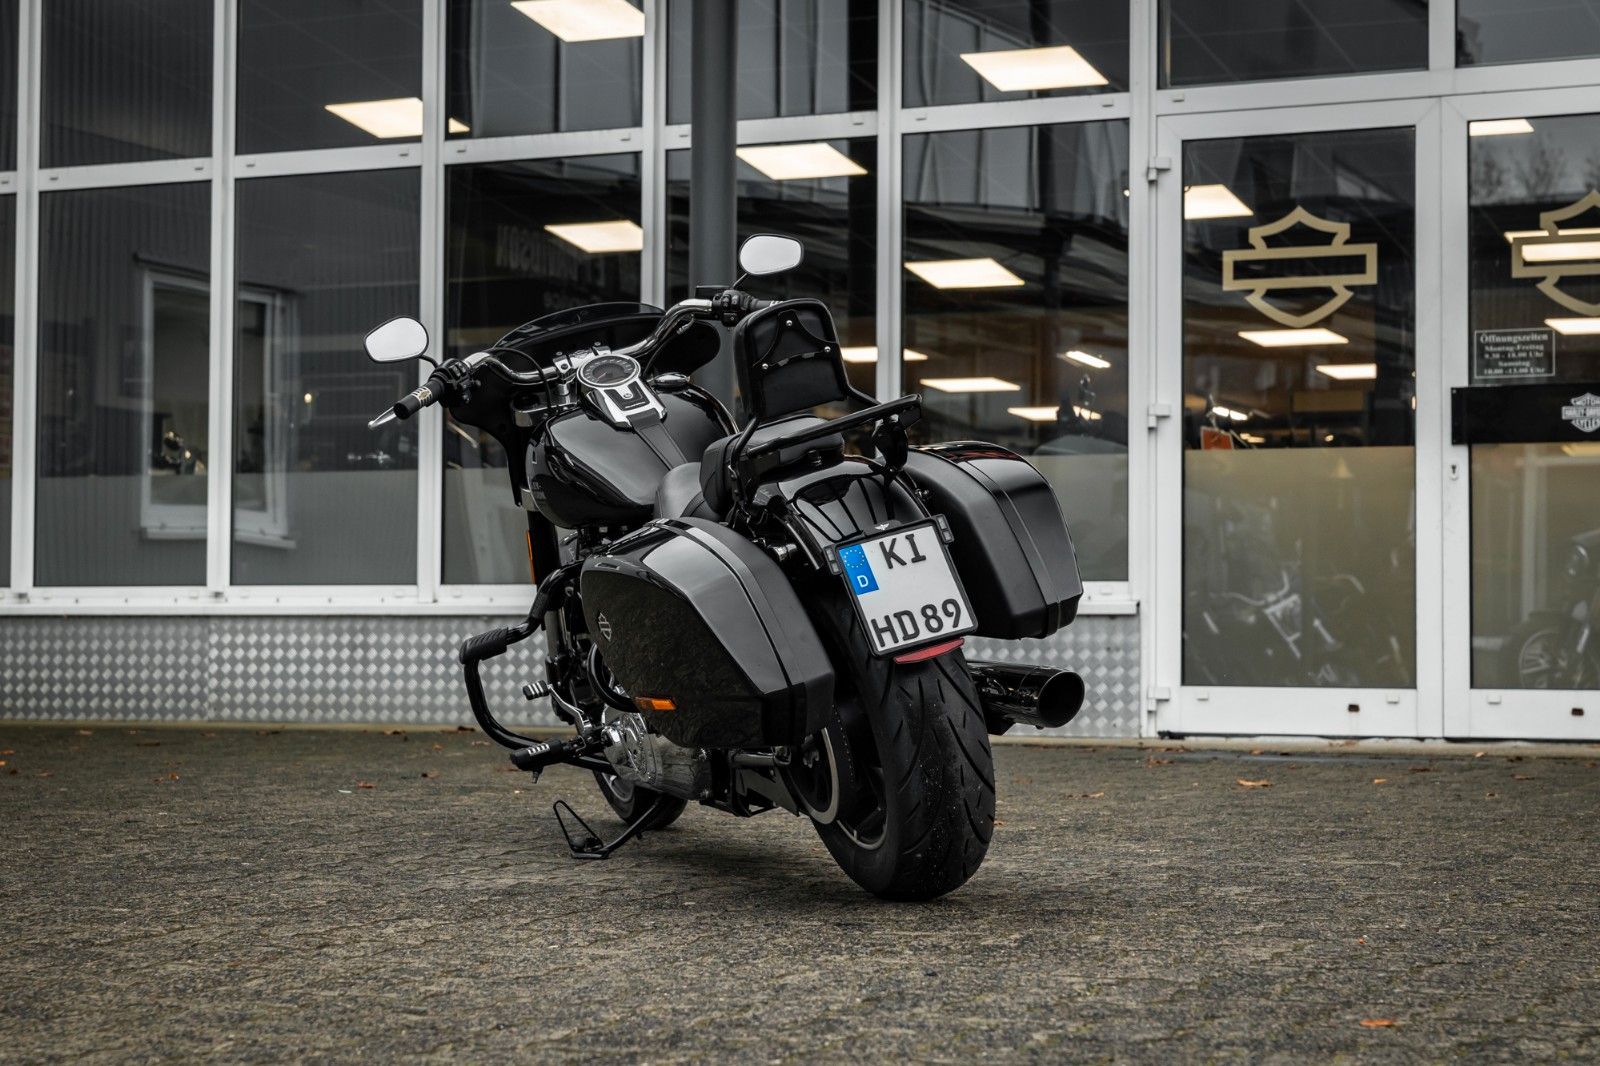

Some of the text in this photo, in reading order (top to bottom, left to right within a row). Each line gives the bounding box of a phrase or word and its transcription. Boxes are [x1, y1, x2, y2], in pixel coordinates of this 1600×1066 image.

[1480, 331, 1548, 343] Öffnungszeiten
[879, 533, 927, 570] KI
[856, 574, 869, 588] D
